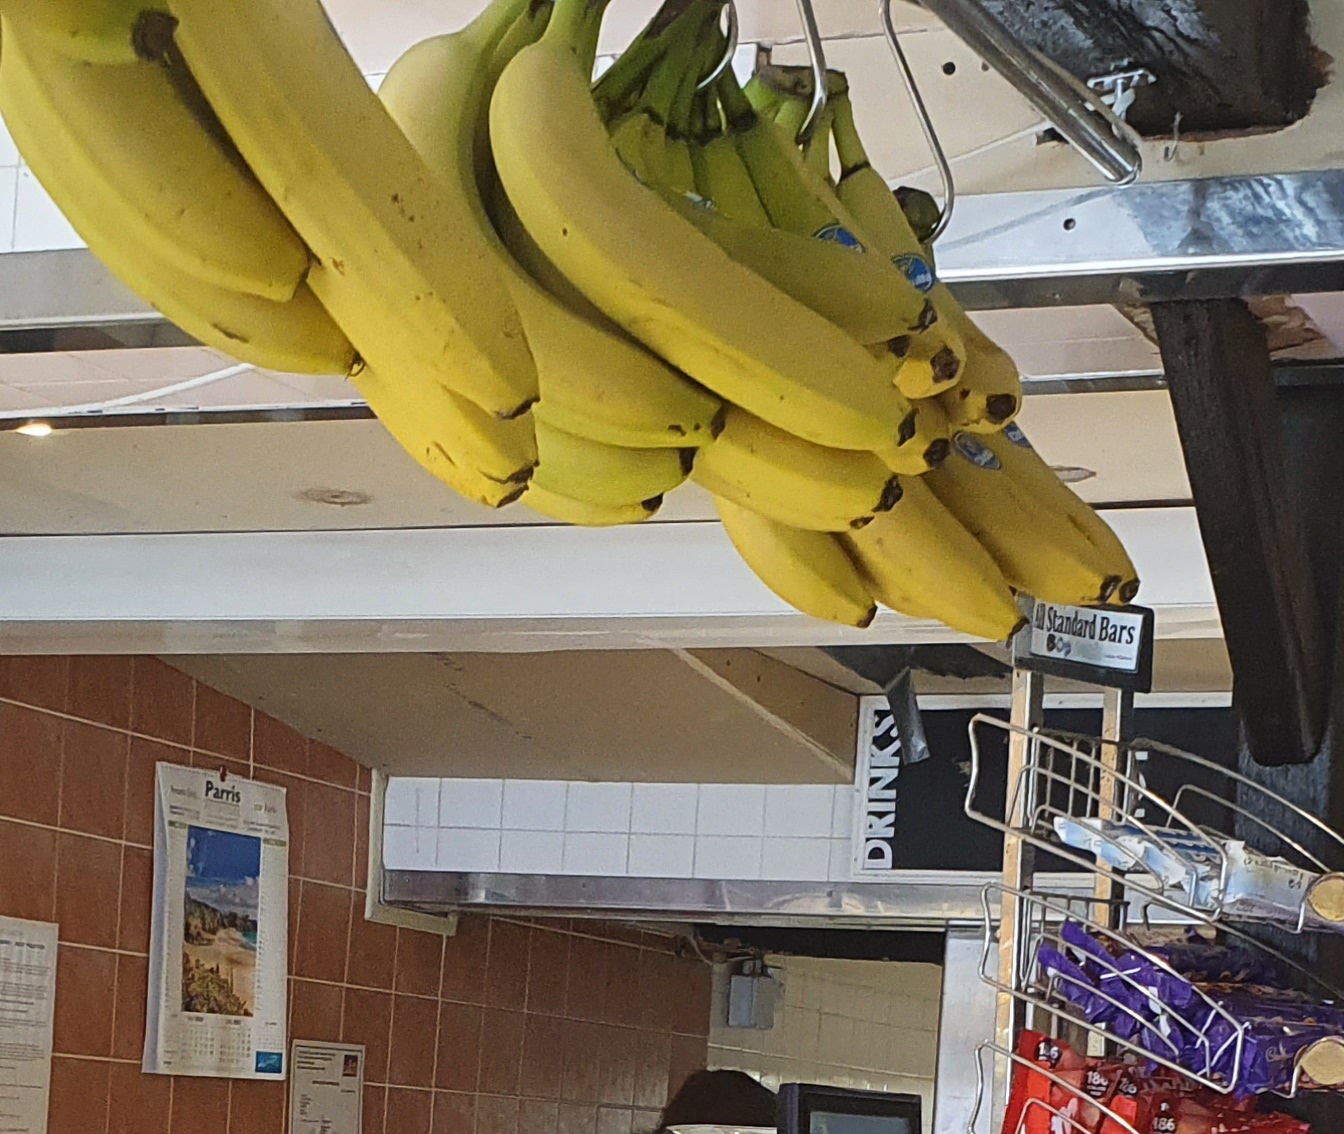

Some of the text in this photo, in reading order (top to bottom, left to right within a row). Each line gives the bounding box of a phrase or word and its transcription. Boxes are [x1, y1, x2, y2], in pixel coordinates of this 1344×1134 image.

[1046, 606, 1097, 640] Standard
[1099, 616, 1136, 645] Bars
[204, 780, 241, 803] Parris
[863, 713, 902, 869] DRINKS
[1154, 1117, 1176, 1132] 186
